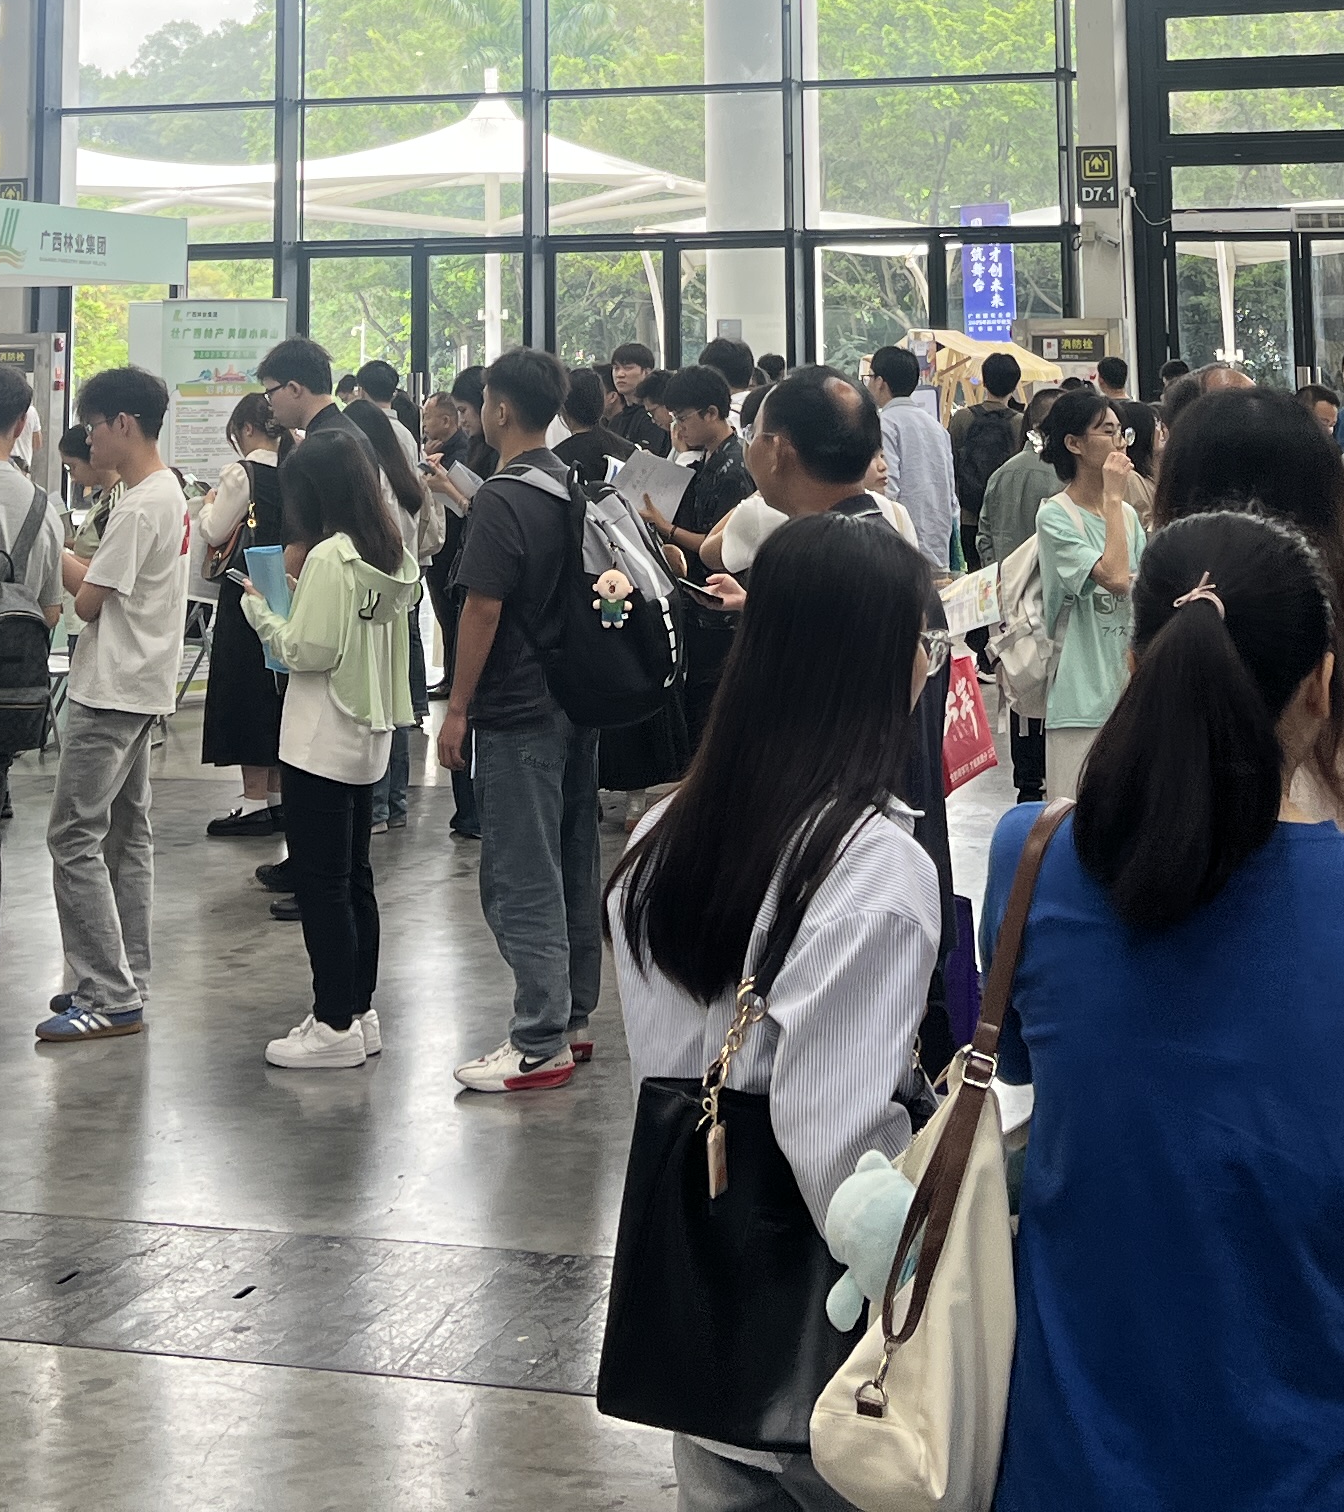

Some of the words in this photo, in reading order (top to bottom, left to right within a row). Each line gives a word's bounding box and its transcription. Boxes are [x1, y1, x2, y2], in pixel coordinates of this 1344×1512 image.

[1081, 186, 1115, 201] D7.1
[39, 230, 107, 256] 广西林业集团
[1061, 338, 1094, 350] 消防栓
